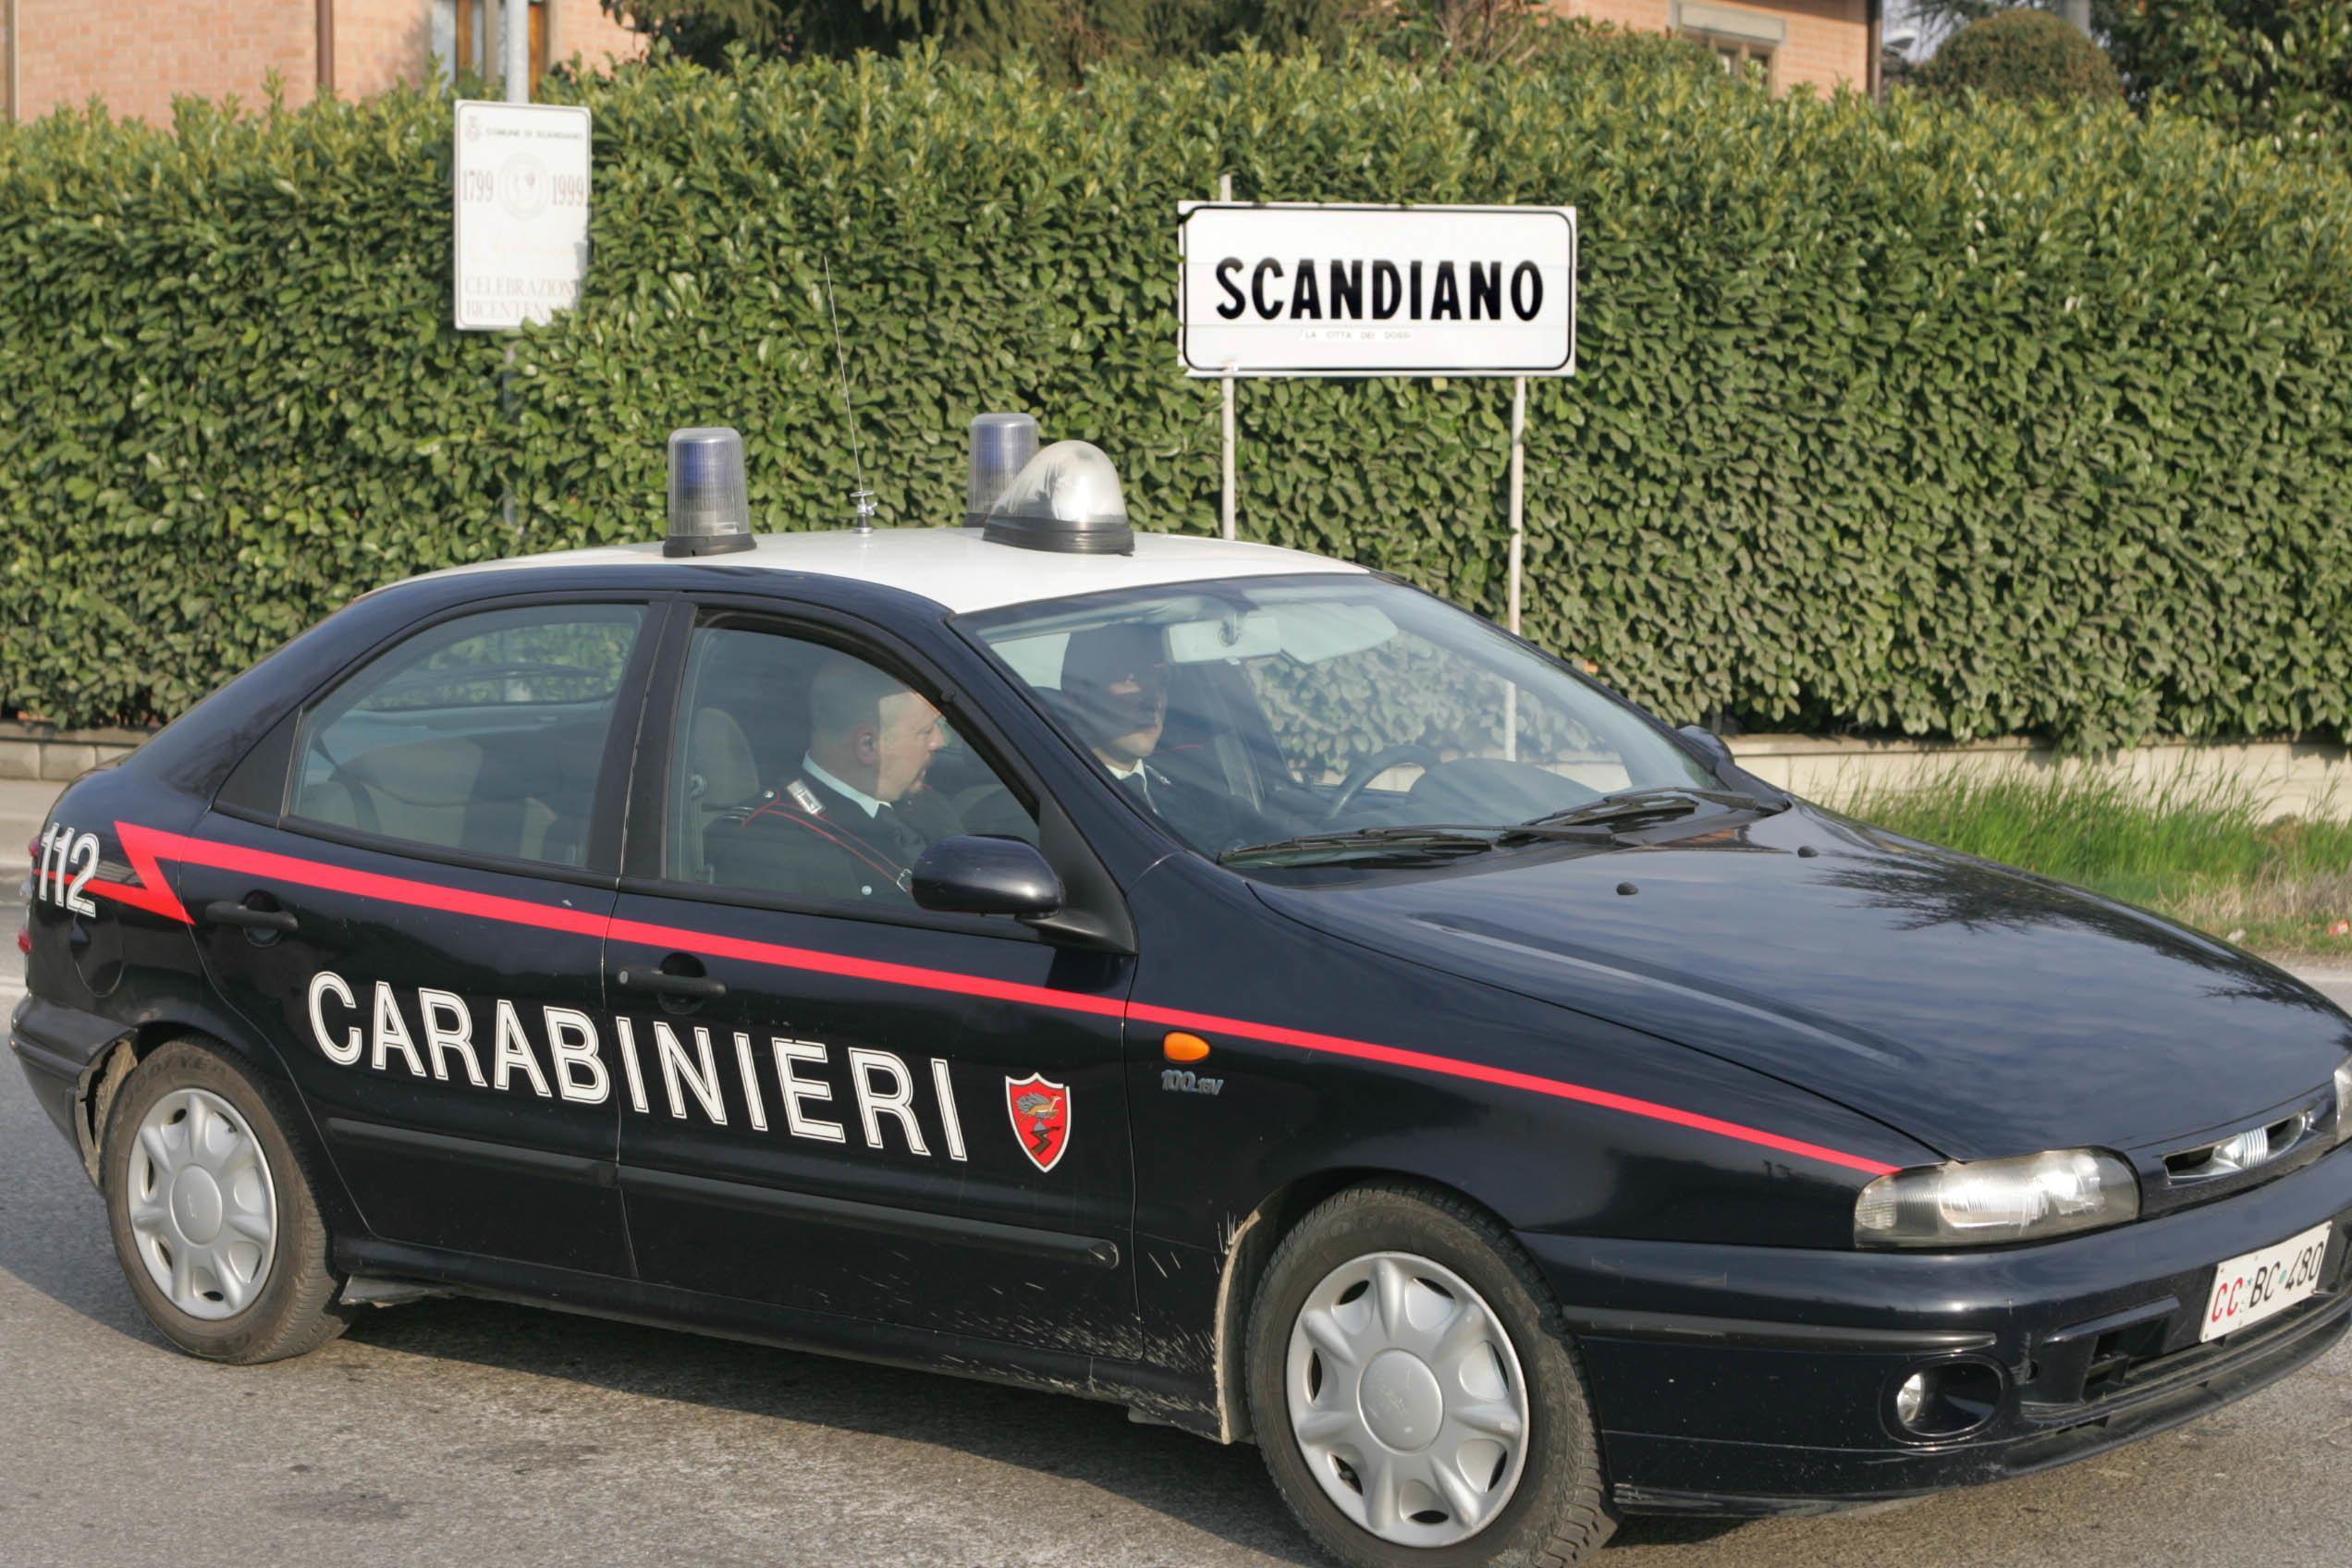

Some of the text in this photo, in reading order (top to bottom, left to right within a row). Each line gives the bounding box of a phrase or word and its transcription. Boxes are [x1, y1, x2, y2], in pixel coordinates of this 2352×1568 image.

[463, 170, 584, 206] 1799 1999
[1216, 257, 1544, 322] SCANDIANO
[39, 822, 100, 918] 112
[308, 971, 968, 1162] CARABINIERI
[2211, 1276, 2245, 1323] CC
[2284, 1241, 2325, 1292] 480
